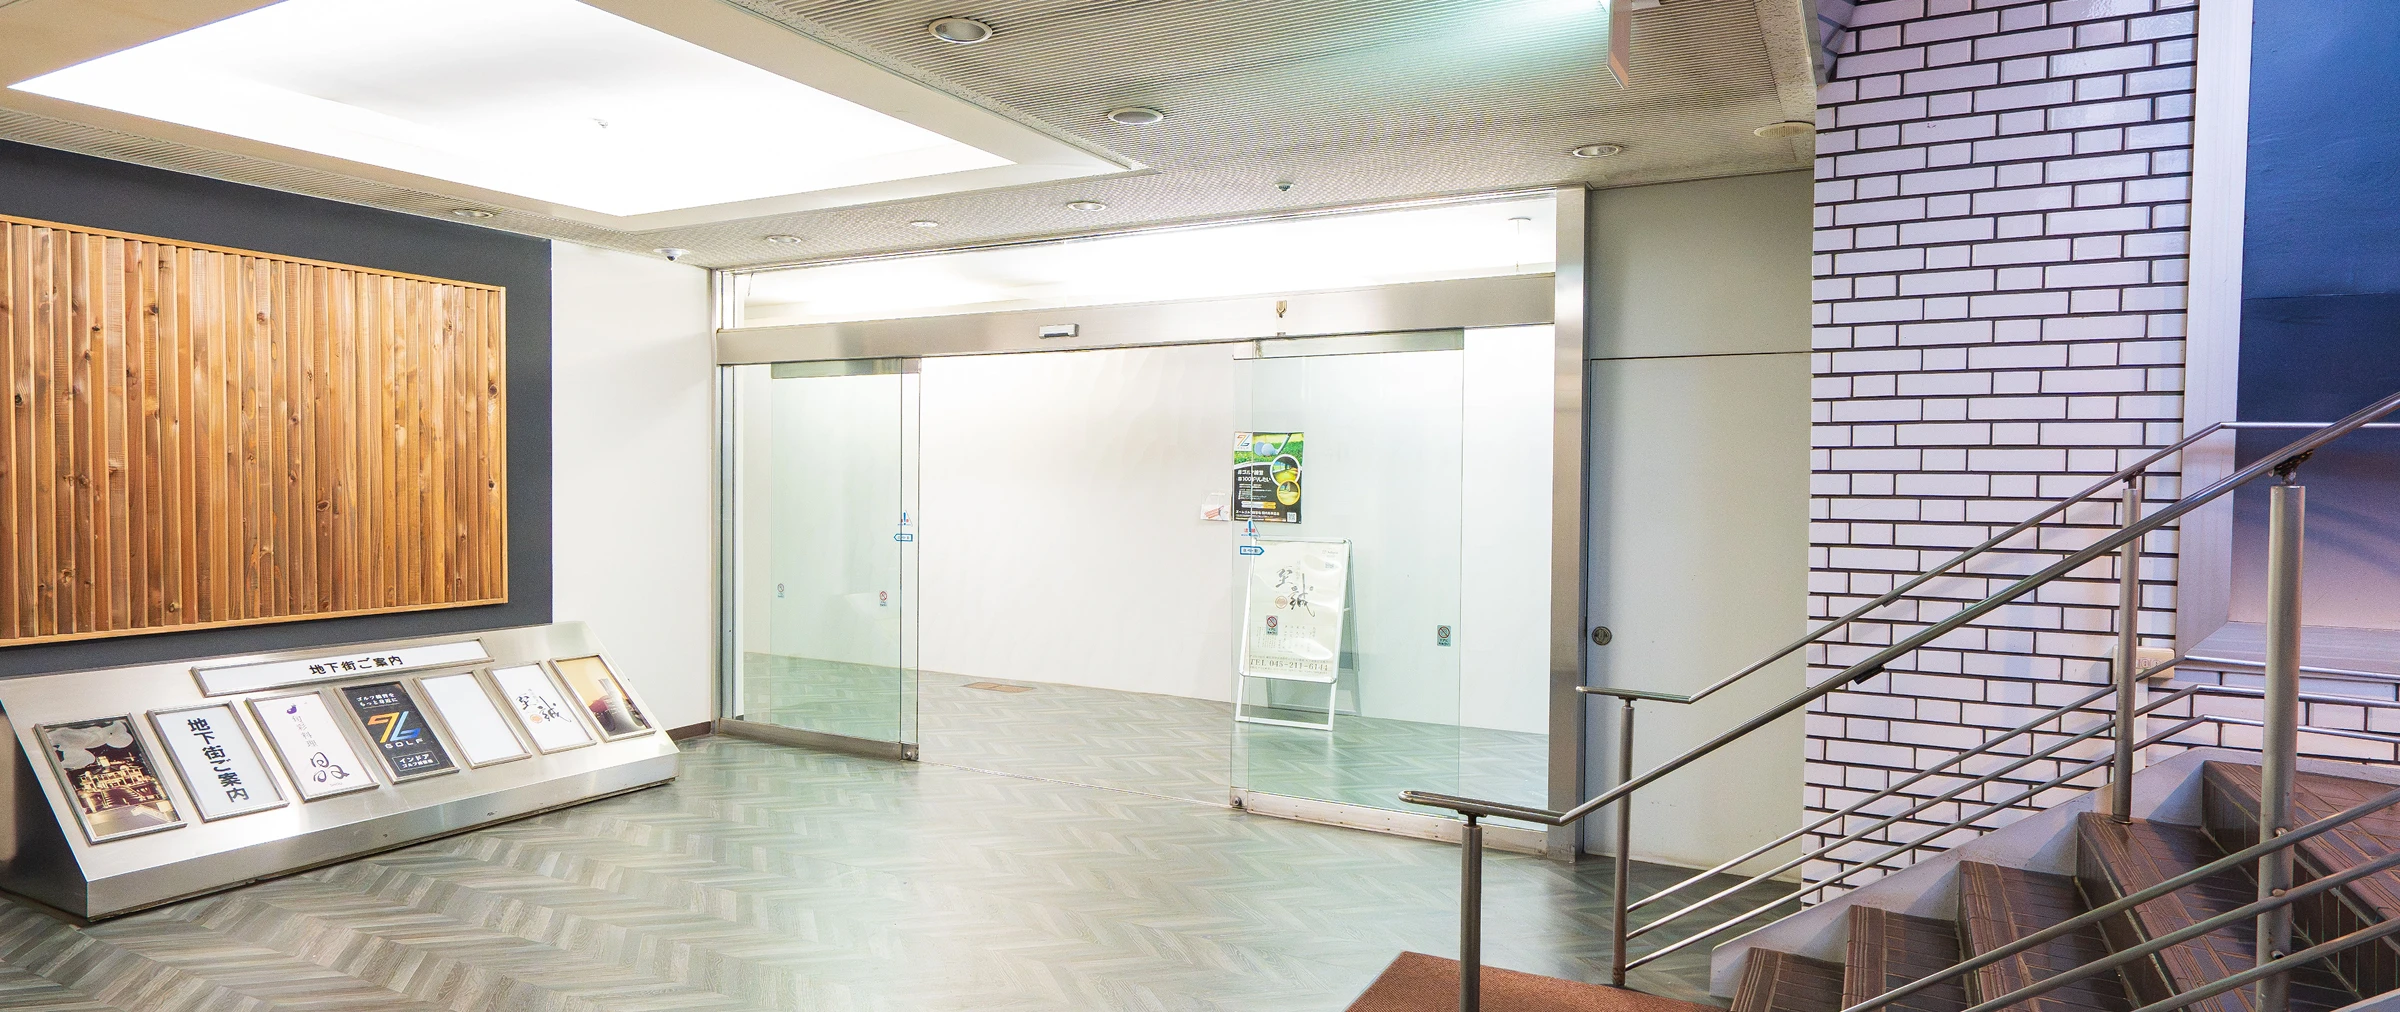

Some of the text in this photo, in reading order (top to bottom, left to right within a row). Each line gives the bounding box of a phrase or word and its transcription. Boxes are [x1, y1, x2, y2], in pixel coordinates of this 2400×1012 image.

[309, 655, 404, 675] 地下街ご案内
[384, 737, 424, 749] GOLF
[187, 717, 250, 803] 地下街ご案内
[399, 753, 430, 764] インドア
